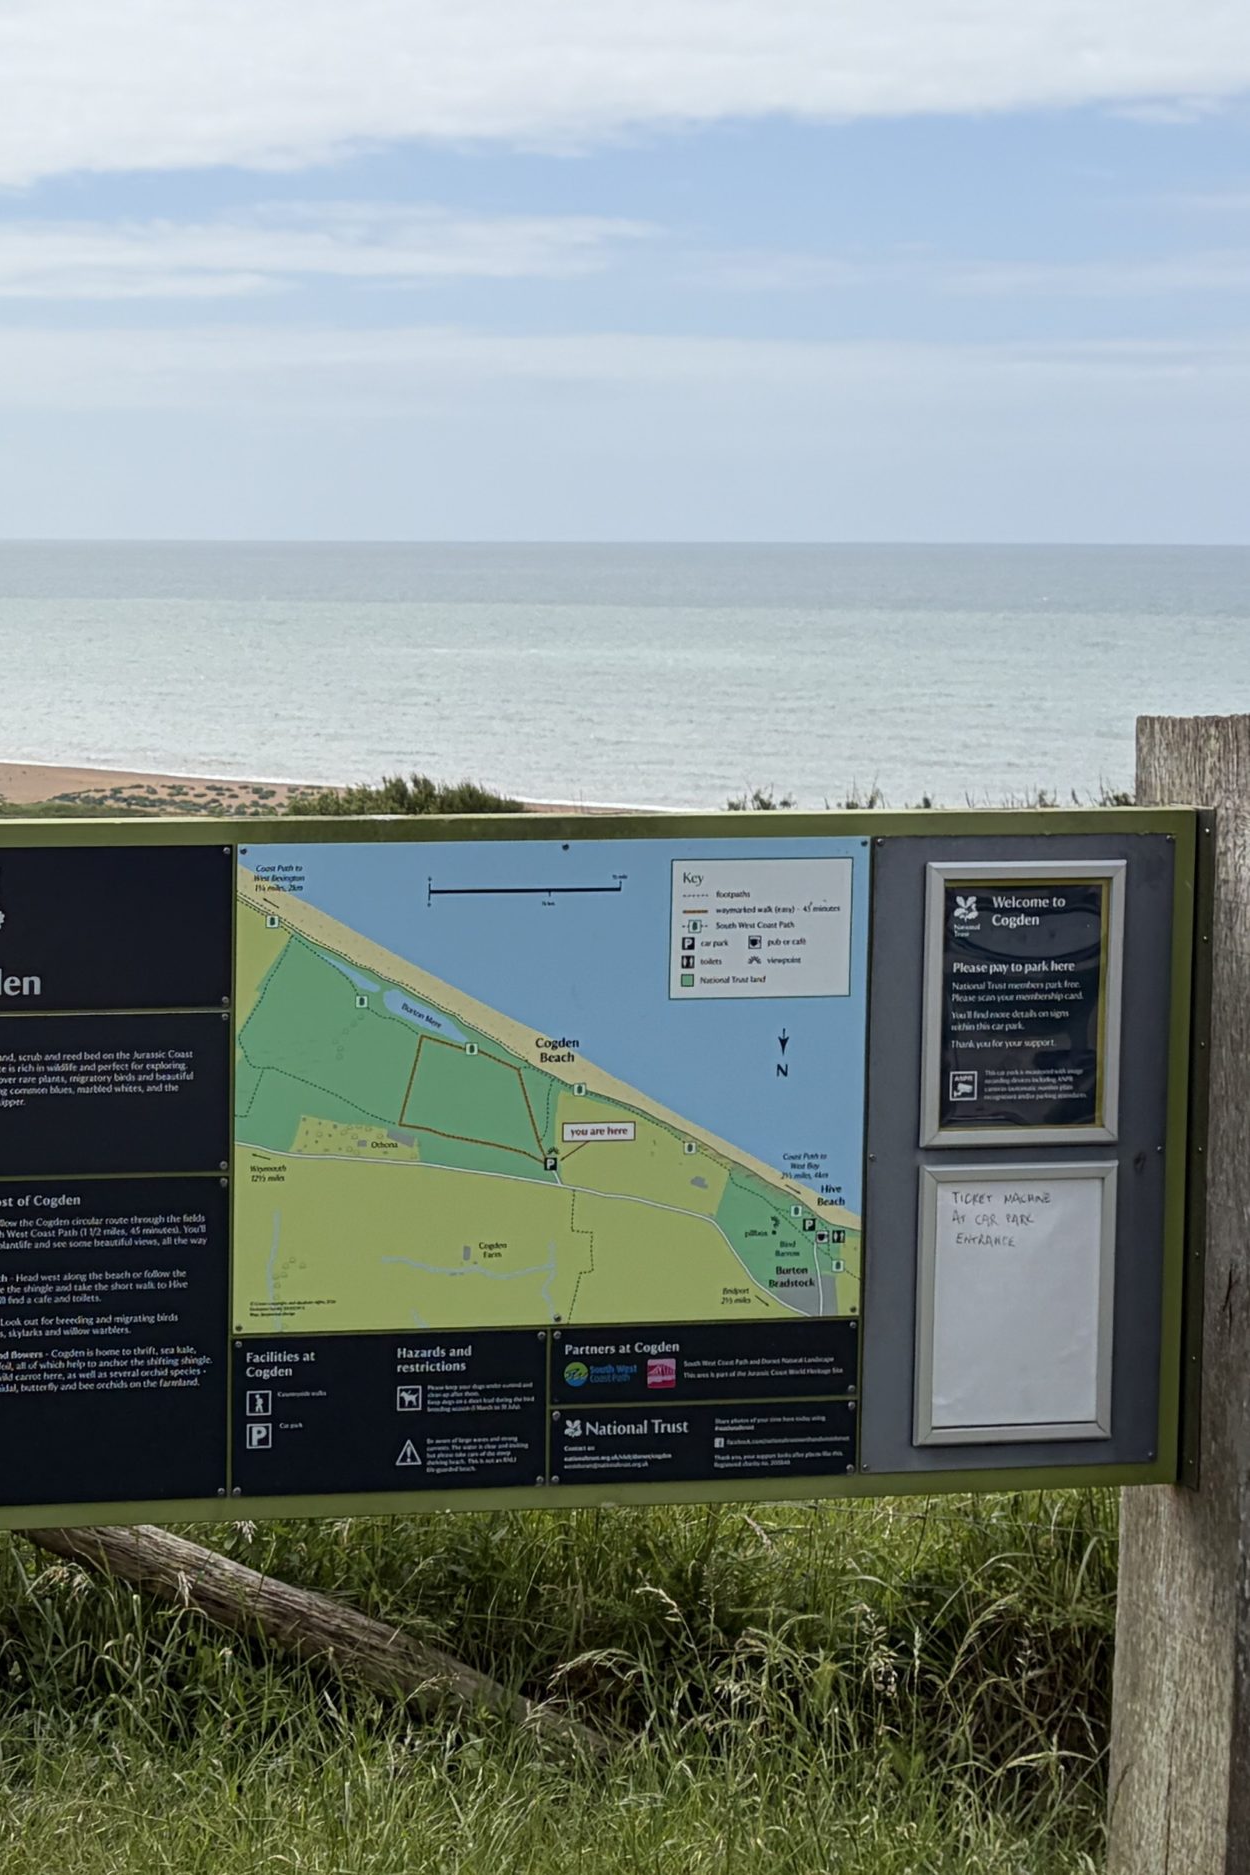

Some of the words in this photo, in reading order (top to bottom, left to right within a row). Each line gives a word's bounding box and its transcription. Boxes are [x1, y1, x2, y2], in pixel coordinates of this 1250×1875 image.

[683, 872, 704, 886] Key
[716, 890, 750, 899] footpaths
[992, 895, 1050, 908] Welcome
[1052, 895, 1066, 907] to
[738, 921, 755, 929] West
[756, 921, 777, 929] Coast
[778, 920, 795, 928] Path
[992, 913, 1039, 929] Cogden
[712, 940, 728, 948] park
[700, 957, 722, 965] toilets
[767, 956, 801, 965] viewpoint
[953, 962, 987, 973] Please
[989, 964, 1009, 975] pay
[1010, 961, 1022, 972] to
[1024, 961, 1048, 975] park
[1050, 960, 1075, 972] here
[700, 975, 730, 984] National
[731, 975, 748, 983] Trust
[749, 975, 766, 983] land
[952, 981, 985, 990] National
[986, 981, 1006, 989] Trust
[1007, 980, 1044, 989] members
[1044, 980, 1062, 991] park
[1063, 980, 1081, 988] free.
[951, 993, 976, 1002] Please
[996, 994, 1014, 1003] your
[1015, 992, 1063, 1003] membership
[1064, 991, 1084, 1000] card.
[951, 1010, 972, 1019] You'll
[972, 1010, 989, 1018] find
[1011, 1009, 1036, 1018] details
[1049, 1008, 1069, 1019] signs
[951, 1022, 975, 1030] within
[976, 1022, 990, 1030] this
[1004, 1021, 1025, 1032] park.
[535, 1036, 580, 1051] Cogden
[951, 1039, 974, 1048] Thank
[976, 1041, 991, 1050] you
[991, 1039, 1003, 1048] for
[1004, 1041, 1022, 1049] your
[1023, 1038, 1056, 1049] support.
[18, 1052, 42, 1061] scrub
[43, 1052, 61, 1060] and
[62, 1051, 82, 1060] reed
[83, 1051, 100, 1060] bed
[115, 1050, 130, 1059] the
[132, 1050, 166, 1059] Jurassic
[167, 1050, 193, 1058] Coast
[540, 1051, 575, 1062] Beach
[8, 1064, 16, 1072] is
[16, 1063, 34, 1072] rich
[35, 1063, 44, 1072] in
[46, 1063, 78, 1072] wildlife
[78, 1062, 96, 1071] and
[97, 1062, 129, 1073] perfect
[130, 1062, 143, 1070] for
[144, 1061, 187, 1072] exploring.
[776, 1063, 788, 1076] N
[37, 1074, 67, 1085] plants,
[68, 1073, 112, 1084] migratory
[113, 1073, 135, 1082] birds
[136, 1072, 154, 1081] and
[154, 1072, 194, 1081] beautiful
[49, 1085, 75, 1095] blues,
[76, 1084, 112, 1093] marbled
[113, 1084, 144, 1094] whites,
[145, 1083, 162, 1092] and
[164, 1083, 179, 1092] the
[570, 1130, 588, 1138] you
[606, 1127, 628, 1135] here
[821, 1183, 842, 1193] Hive
[16, 1196, 31, 1206] of
[32, 1195, 81, 1209] Cogden
[817, 1195, 845, 1206] Beach
[18, 1218, 34, 1227] the
[35, 1218, 69, 1228] Cogden
[70, 1217, 103, 1226] circular
[104, 1216, 128, 1225] route
[129, 1215, 165, 1226] through
[166, 1215, 181, 1224] the
[182, 1214, 205, 1223] fields
[478, 1241, 507, 1250] Cogden
[956, 1232, 1016, 1247] ENTRANCE
[775, 1264, 808, 1275] Burton
[768, 1276, 814, 1288] Bradstock
[397, 1345, 446, 1358] Hazards
[448, 1344, 472, 1357] and
[564, 1342, 616, 1354] Partners
[618, 1342, 631, 1353] at
[632, 1341, 680, 1356] Cogden
[246, 1351, 300, 1362] Facilities
[302, 1351, 315, 1362] at
[397, 1360, 466, 1372] restrictions
[246, 1366, 292, 1380] Cogden
[586, 1420, 648, 1435] National
[651, 1419, 689, 1434] Trust
